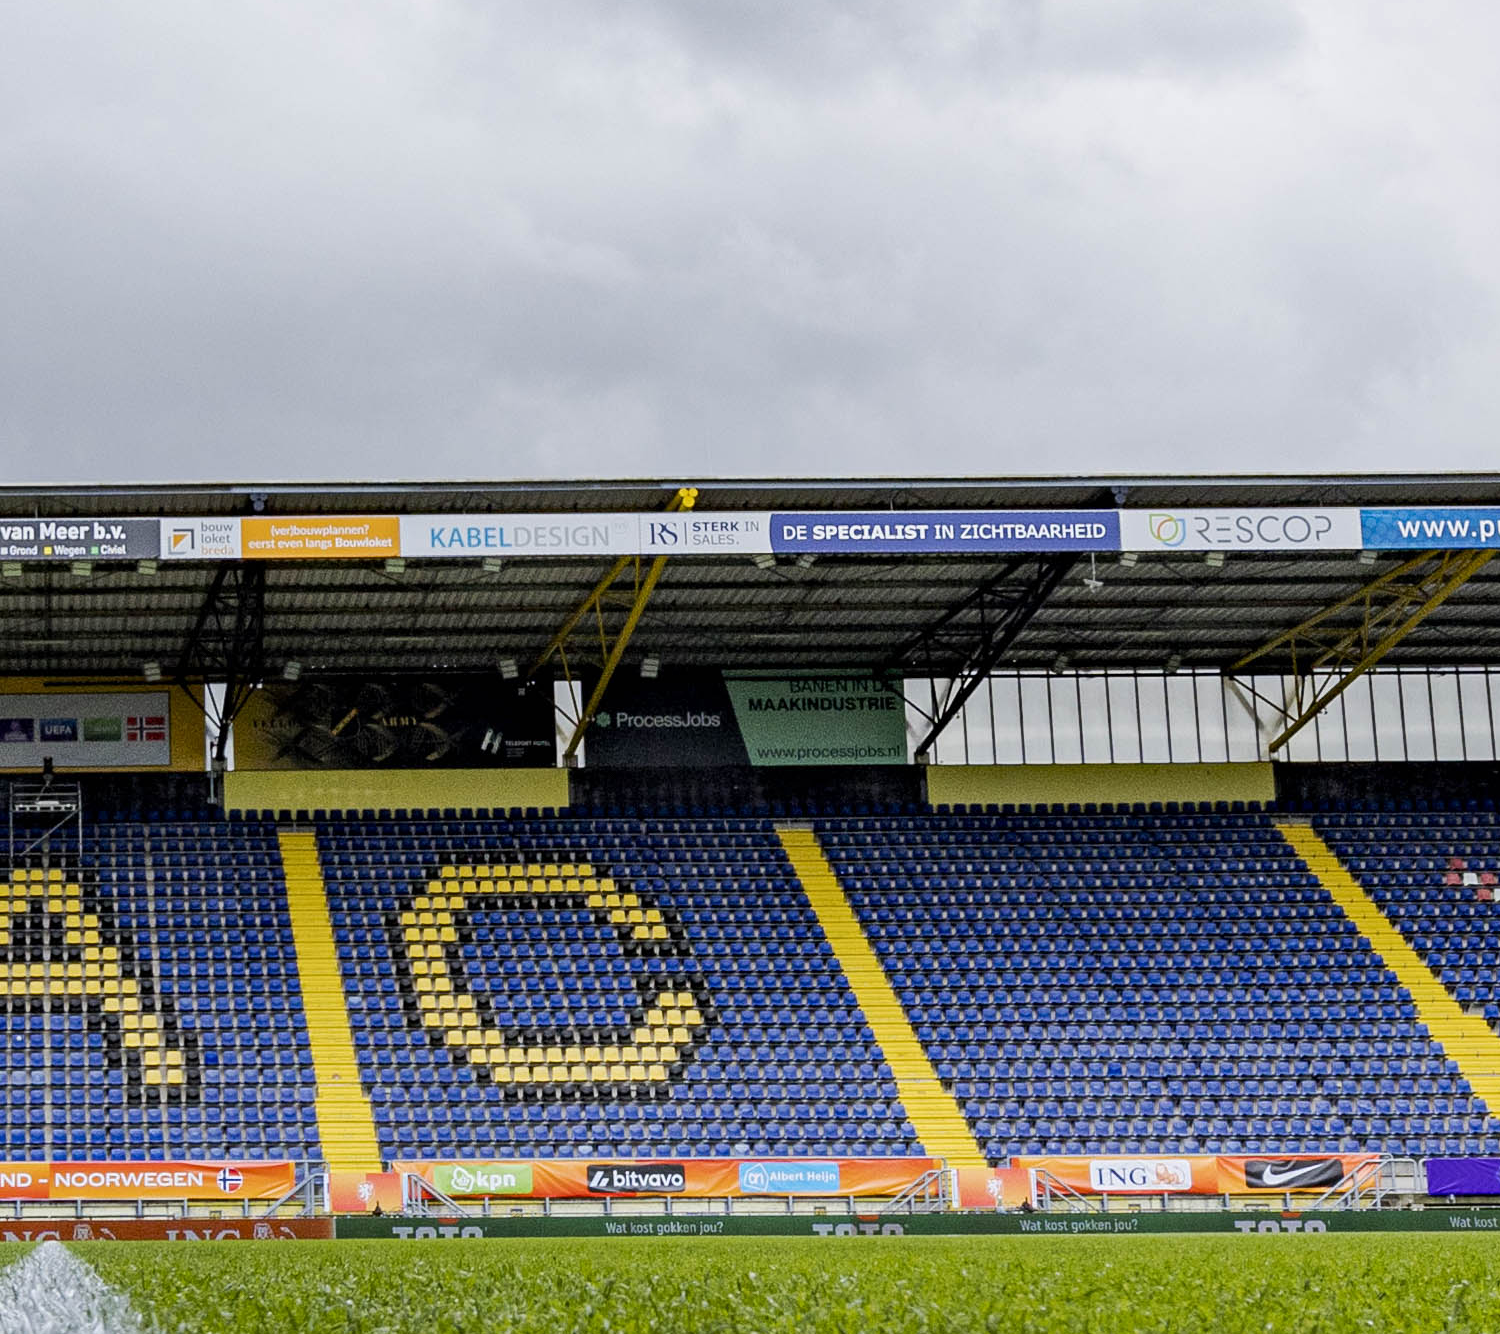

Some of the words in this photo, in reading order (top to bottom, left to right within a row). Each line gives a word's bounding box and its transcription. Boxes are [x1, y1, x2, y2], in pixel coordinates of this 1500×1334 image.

[0, 526, 35, 541] van
[39, 522, 90, 541] Meer
[93, 522, 127, 540] b.v.
[200, 522, 233, 532] bouw
[269, 524, 371, 537] (ver)bouwplannen?
[692, 521, 740, 533] STERK
[744, 520, 760, 532] IN
[783, 525, 808, 541] DE
[812, 524, 929, 540] SPECIALIST
[934, 524, 955, 540] IN
[959, 523, 1107, 540] ZICHTBAARHEID
[1194, 515, 1332, 544] RESCOP
[200, 533, 231, 544] loket
[248, 537, 275, 550] eerst
[277, 539, 304, 549] even
[305, 537, 333, 550] langs
[334, 536, 393, 549] Bouwloket
[430, 525, 610, 549] KABELDESIGN
[692, 533, 740, 546] SALES.
[9, 545, 38, 556] Grond
[54, 545, 87, 558] Wegen
[100, 544, 127, 555] Civiel
[200, 544, 234, 556] breda
[789, 679, 848, 694] BANEN
[852, 679, 868, 693] IN
[748, 696, 898, 713] MAAKINDUSTRIE
[616, 710, 721, 730] ProcessJobs
[44, 725, 73, 737] UEFA
[757, 745, 901, 761] www.processjobs.nl
[54, 1171, 204, 1188] NOORWEGEN
[475, 1172, 517, 1192] kpn
[613, 1170, 685, 1189] bitvavo
[770, 1170, 804, 1182] Albert
[807, 1170, 837, 1184] Heijn
[1097, 1168, 1147, 1186] ING
[606, 1223, 627, 1234] Wat
[631, 1223, 653, 1234] kost
[657, 1222, 697, 1235] gokken
[700, 1221, 724, 1235] jou?
